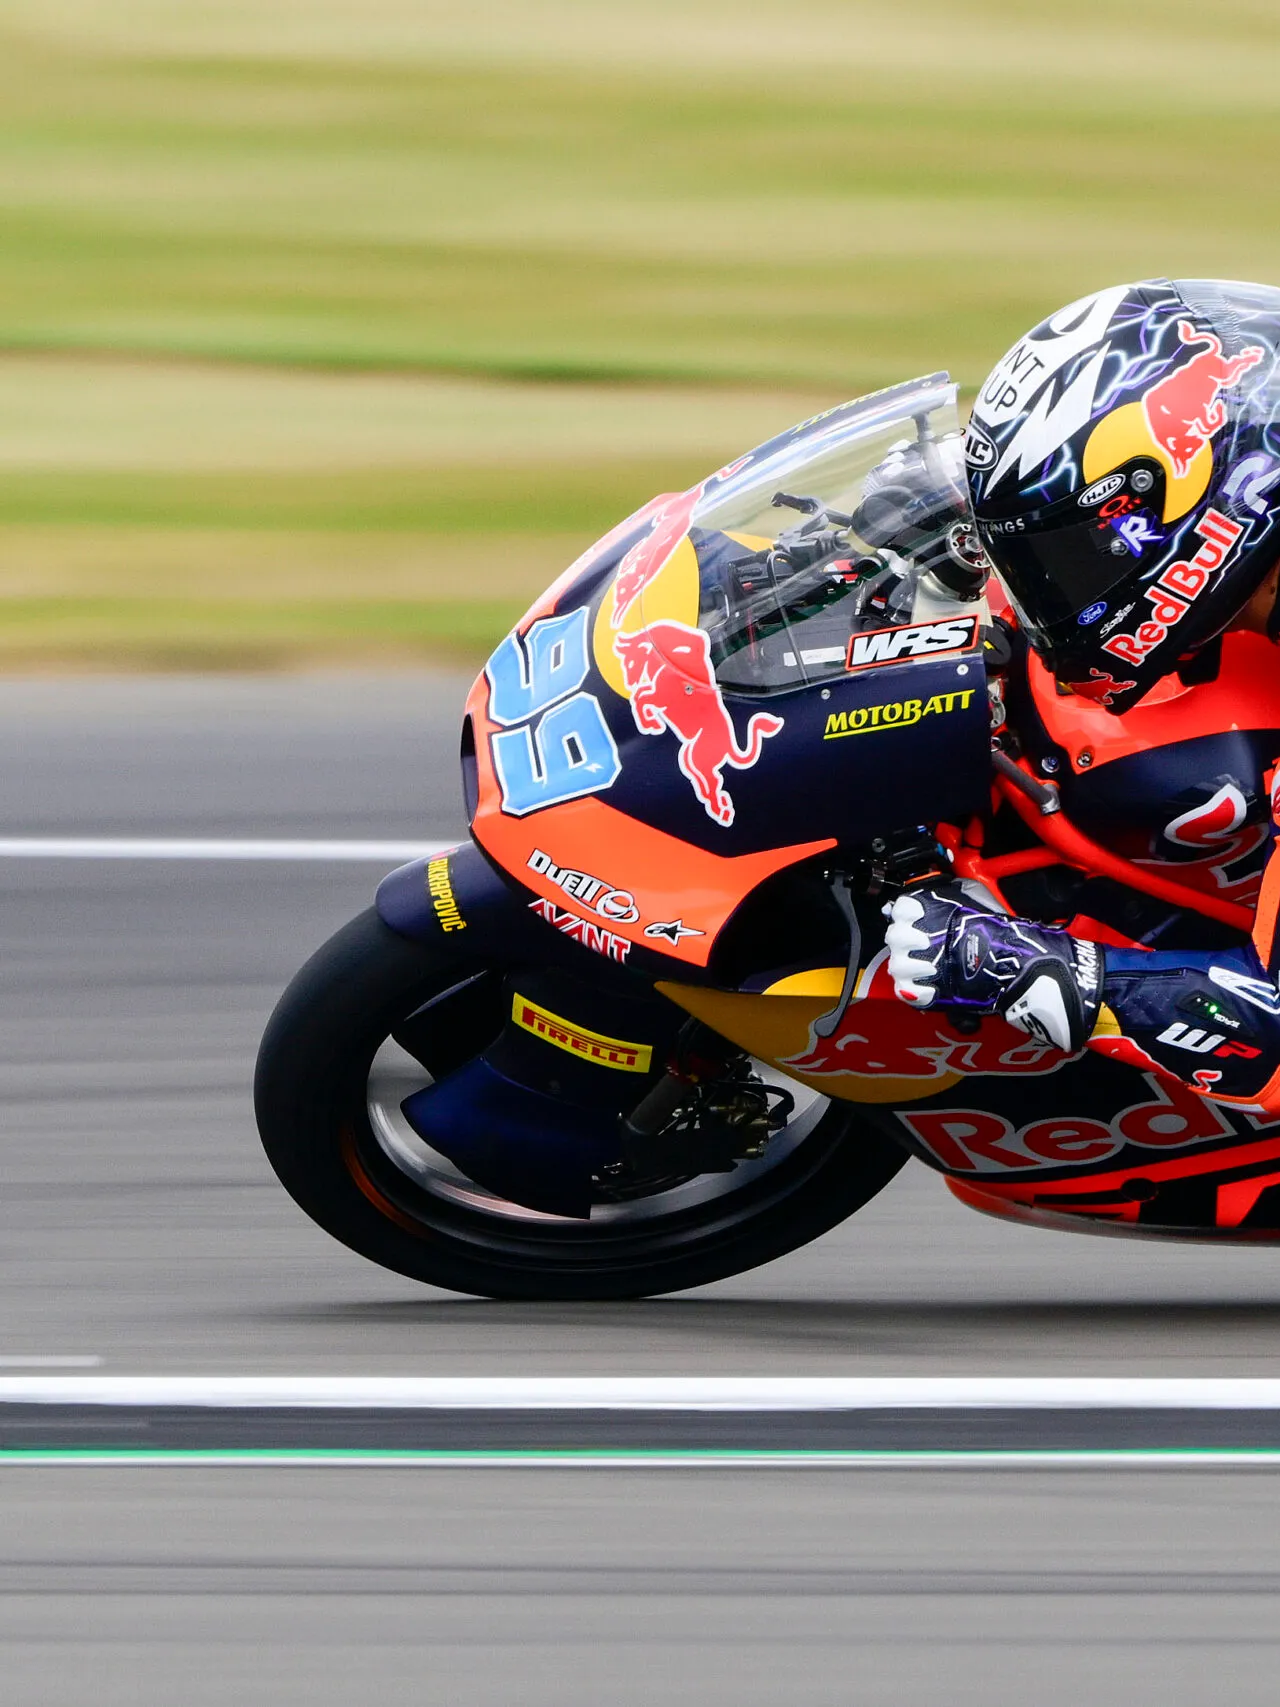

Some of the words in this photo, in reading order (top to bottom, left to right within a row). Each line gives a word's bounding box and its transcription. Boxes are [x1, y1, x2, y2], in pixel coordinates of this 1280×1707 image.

[1086, 478, 1118, 502] HJC
[1102, 585, 1191, 667] Red
[1158, 507, 1244, 601] Bull
[852, 618, 975, 666] WRS
[823, 690, 976, 740] MOTOBATT
[528, 898, 632, 964] AVANT
[521, 1005, 639, 1067] PIRELLI
[1156, 1022, 1263, 1059] WP
[893, 1073, 1238, 1173] Red
